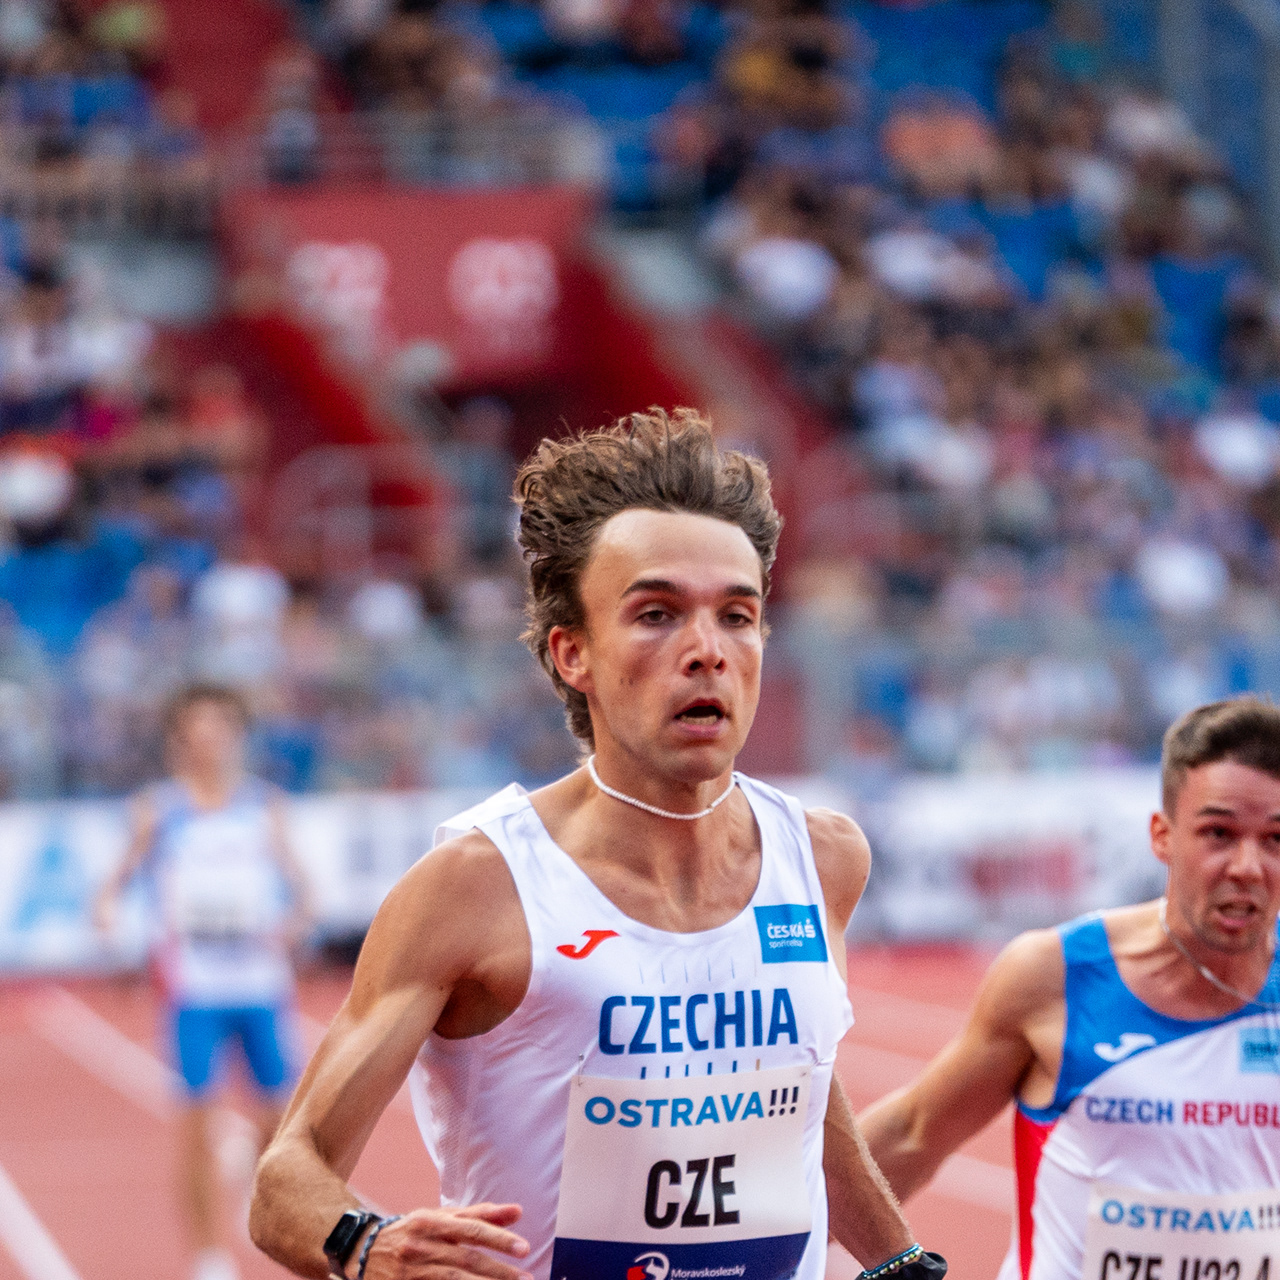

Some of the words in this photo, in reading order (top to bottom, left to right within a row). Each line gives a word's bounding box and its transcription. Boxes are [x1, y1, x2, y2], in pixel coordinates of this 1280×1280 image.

[767, 922, 805, 938] ČESKÁ
[598, 987, 799, 1056] CZECHIA
[583, 1085, 800, 1129] OSTRAVA!!!
[1085, 1096, 1174, 1125] CZECH
[643, 1153, 741, 1230] CZE
[670, 1264, 746, 1279] Moravskoslezský
